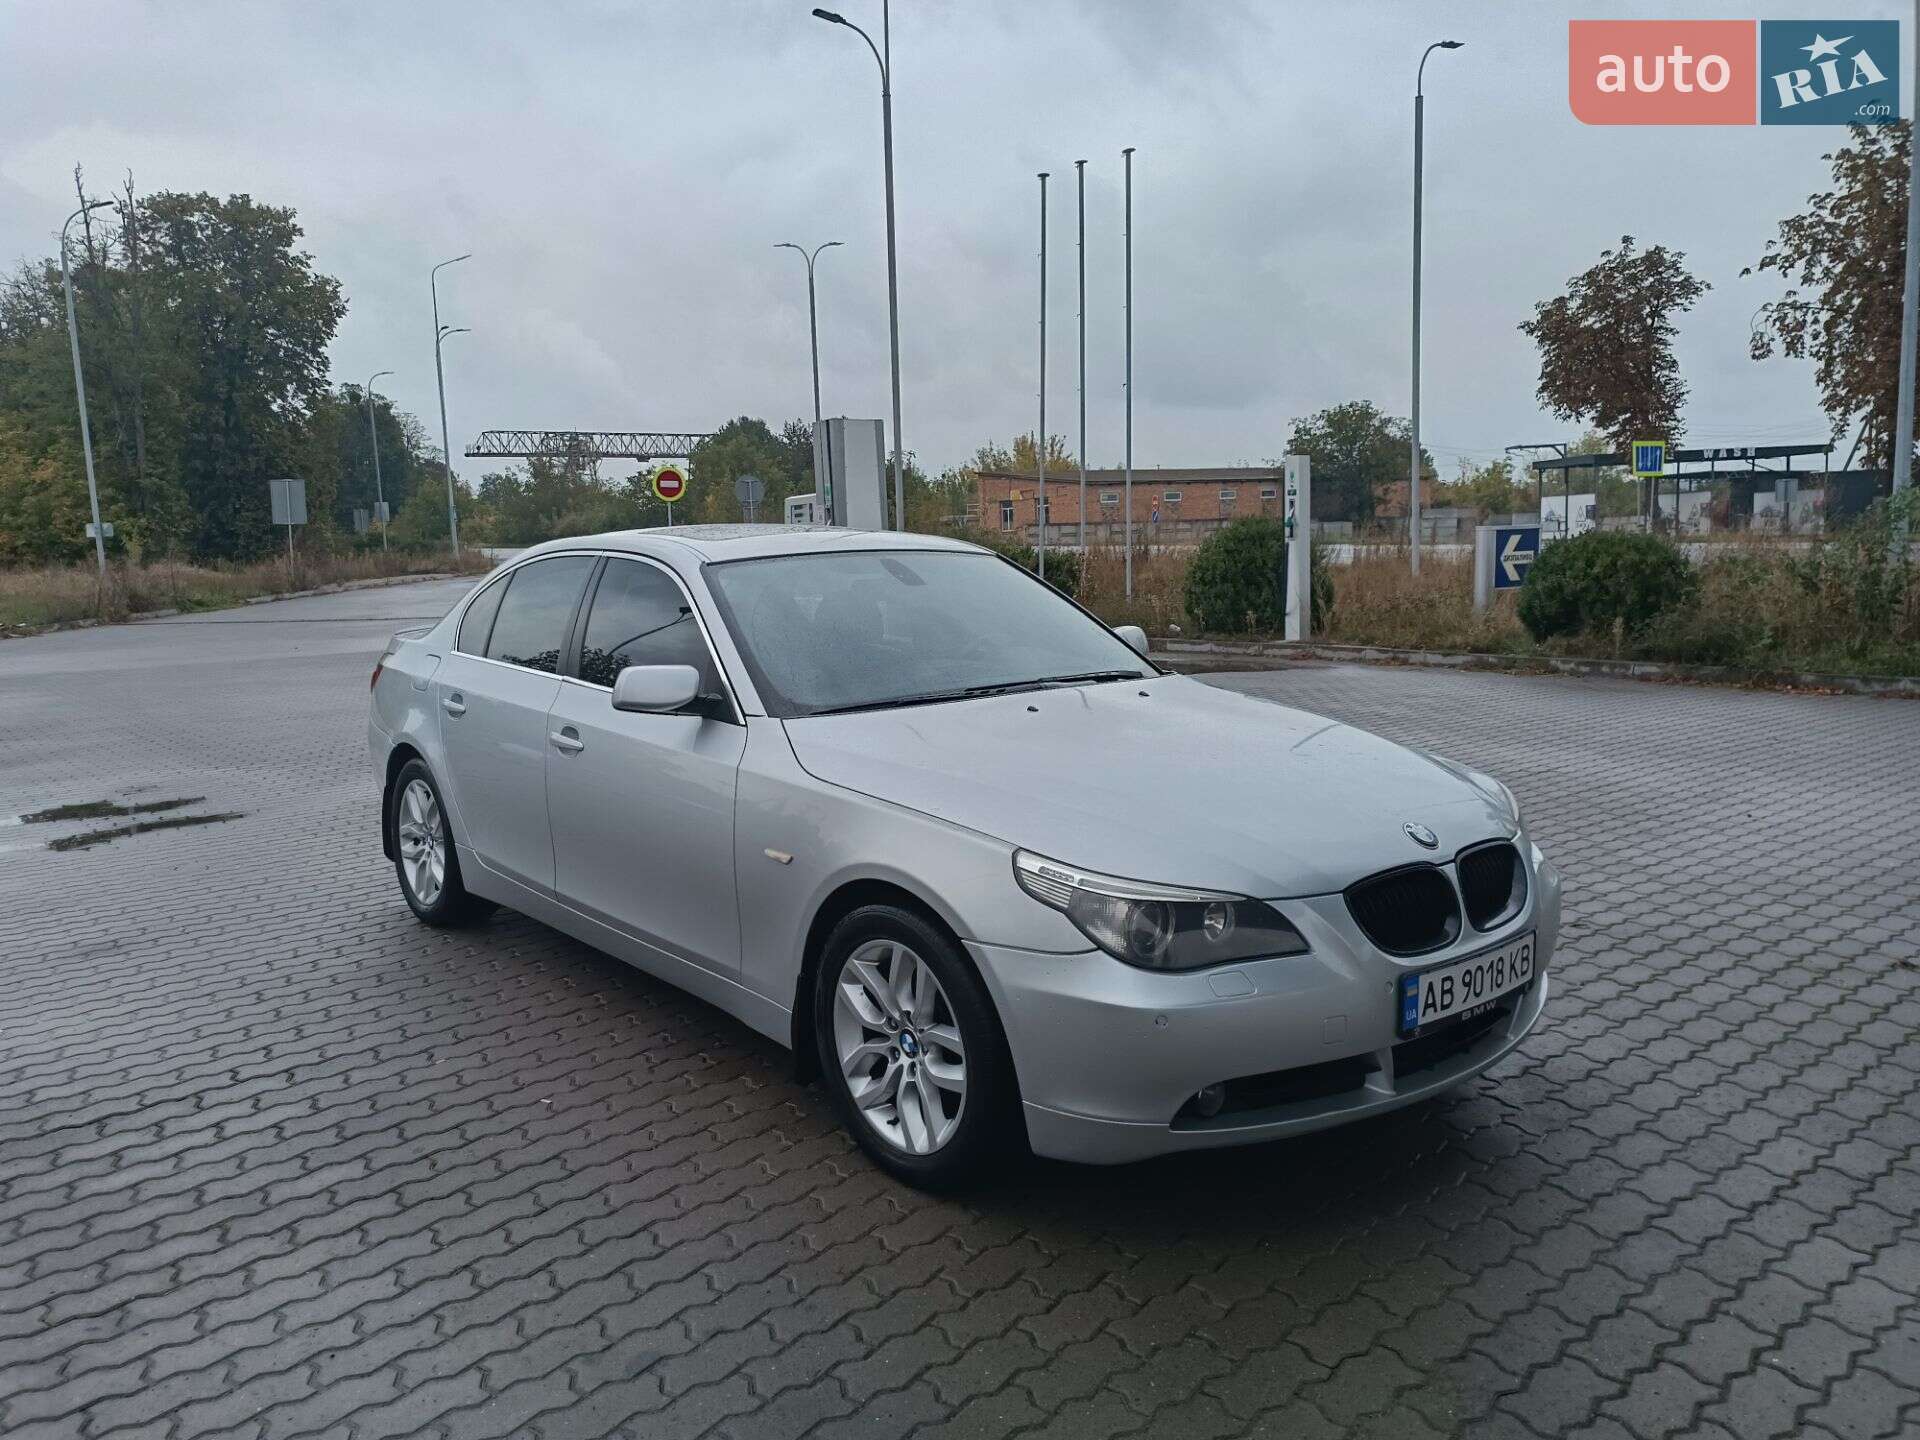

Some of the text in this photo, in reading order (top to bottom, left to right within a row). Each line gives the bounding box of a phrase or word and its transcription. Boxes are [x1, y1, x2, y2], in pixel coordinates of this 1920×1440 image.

[1422, 944, 1530, 1017] AB 9018 KB
[1406, 1009, 1417, 1020] UA
